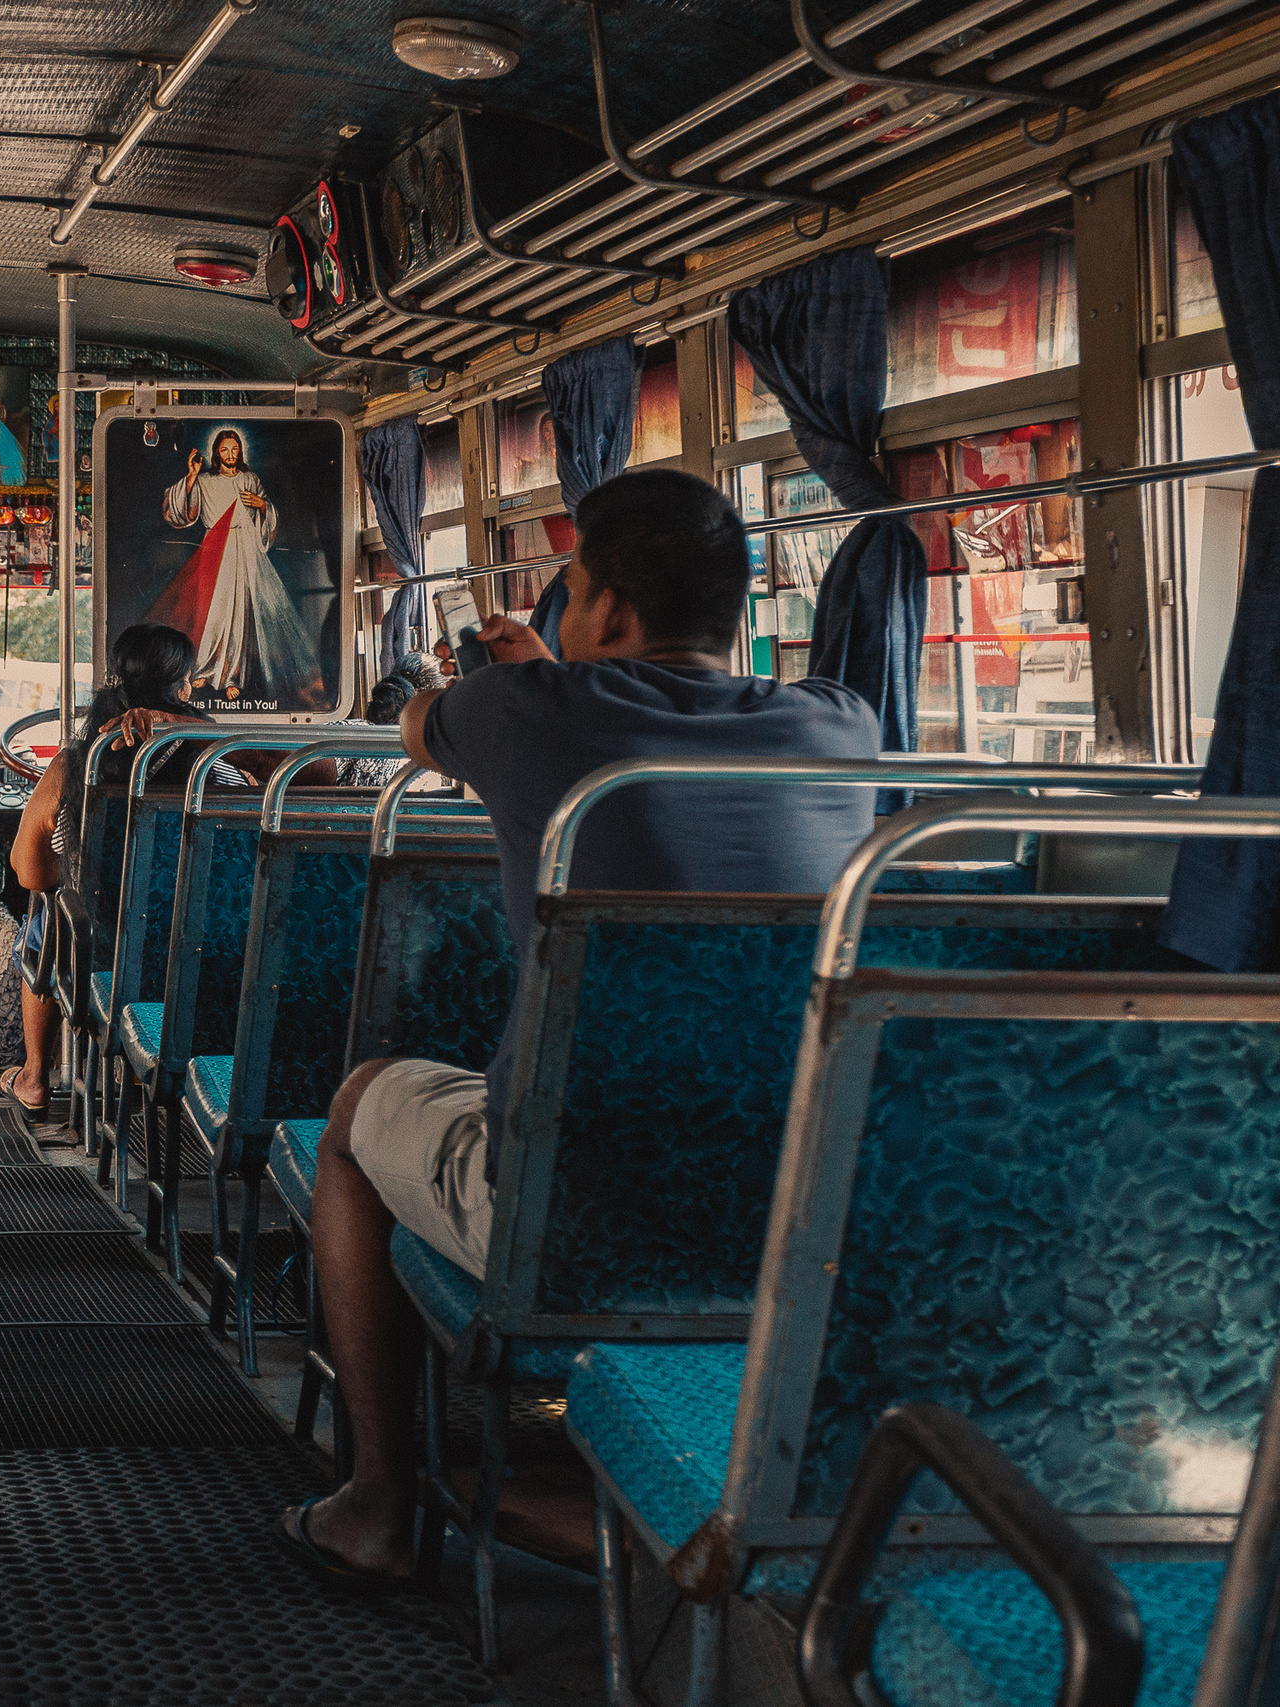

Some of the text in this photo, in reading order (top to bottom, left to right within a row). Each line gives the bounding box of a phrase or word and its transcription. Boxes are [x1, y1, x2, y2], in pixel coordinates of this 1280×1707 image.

[208, 699, 212, 710] I
[214, 699, 240, 710] Trust
[242, 699, 252, 710] in
[254, 699, 278, 710] You!
